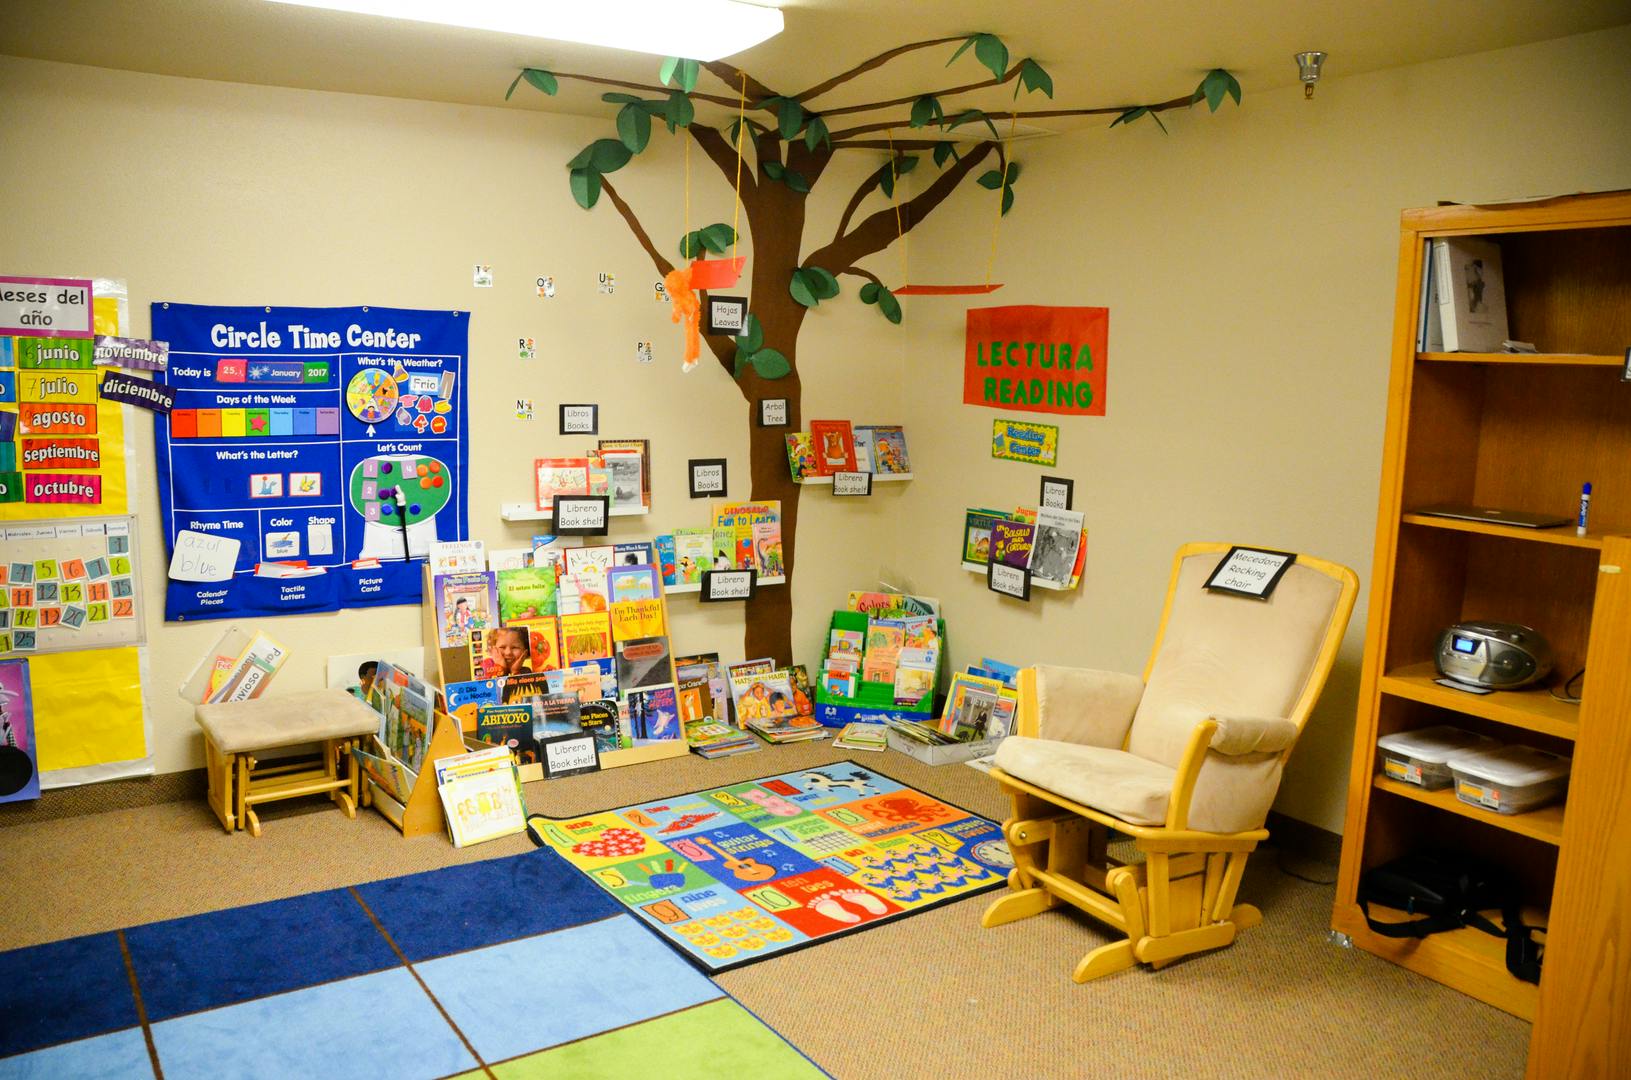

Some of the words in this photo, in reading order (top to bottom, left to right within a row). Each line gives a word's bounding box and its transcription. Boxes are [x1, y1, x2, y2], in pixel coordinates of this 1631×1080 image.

[0, 288, 47, 303] eses
[57, 289, 84, 305] del
[716, 304, 738, 316] Hojas
[20, 311, 53, 325] año
[714, 318, 739, 327] Leaves
[210, 321, 281, 348] Circle
[288, 324, 341, 349] Time
[346, 323, 421, 349] Center
[37, 344, 79, 365] junio
[94, 343, 166, 366] noviembre
[976, 341, 1094, 372] LECTURA
[357, 356, 387, 366] What's
[403, 358, 443, 368] Weather?
[172, 367, 201, 378] Today
[203, 367, 211, 377] is
[270, 369, 300, 379] January
[308, 368, 327, 377] 2017
[39, 377, 78, 399] julio
[103, 379, 173, 408] diciembre
[983, 377, 1094, 408] READING
[217, 395, 238, 406] Days
[239, 395, 250, 404] of
[252, 395, 267, 404] the
[270, 395, 296, 404] Week
[32, 411, 86, 428] agosto
[567, 409, 589, 418] Libros
[766, 414, 783, 423] Tree
[567, 421, 589, 430] Books
[1007, 425, 1045, 445] Reading
[377, 443, 395, 452] Let's
[397, 443, 422, 452] Count
[1009, 442, 1041, 458] Center
[24, 446, 99, 462] septiembre
[216, 450, 247, 460] What's
[249, 450, 265, 459] the
[267, 449, 299, 459] Letter?
[696, 468, 720, 477] Libros
[34, 480, 94, 498] octubre
[697, 481, 719, 489] Books
[1045, 485, 1065, 496] Libros
[566, 503, 597, 513] Librero
[1046, 498, 1064, 510] Books
[190, 520, 219, 531] Rhyme
[222, 519, 244, 529] Time
[270, 517, 293, 527] Color
[308, 516, 335, 525] Shape
[560, 516, 583, 526] Book
[585, 516, 603, 526] shelf
[717, 515, 735, 527] Fun
[738, 515, 747, 525] to
[750, 514, 776, 526] Learn
[180, 555, 217, 577] blue
[1232, 552, 1281, 568] Mecedora
[1229, 564, 1266, 580] Rocking
[359, 576, 383, 586] Picture
[717, 576, 745, 584] Librero
[1224, 577, 1252, 590] chair
[39, 584, 57, 600] 12
[196, 589, 229, 599] Calendar
[280, 585, 305, 594] Tactile
[361, 585, 381, 593] Cards
[711, 588, 729, 596] Book
[731, 587, 749, 596] shelf
[200, 597, 224, 606] Pieces
[280, 593, 305, 601] Letters
[113, 602, 132, 617] 22
[859, 599, 891, 613] Colors
[481, 712, 530, 726] ABIYOYO
[554, 744, 587, 755] Librero
[551, 759, 570, 770] Book
[573, 754, 595, 765] shelf
[681, 889, 718, 904] nine
[752, 890, 792, 909] 10
